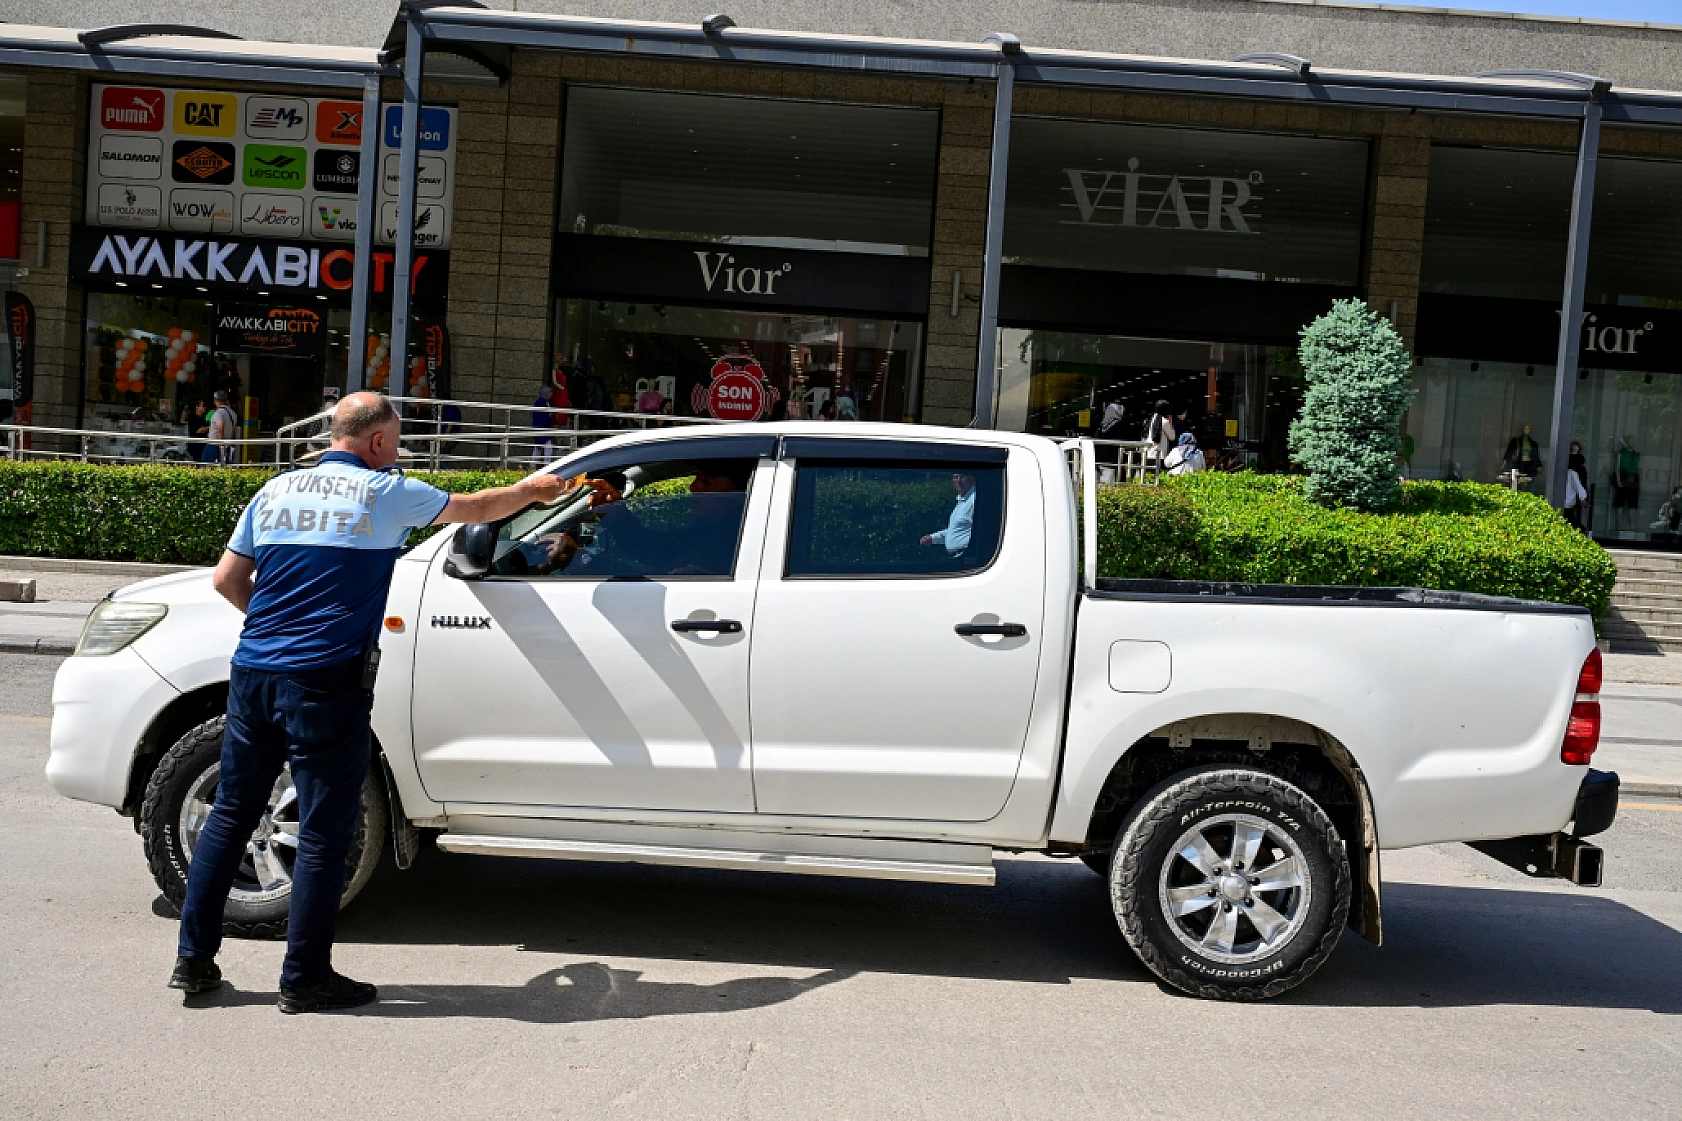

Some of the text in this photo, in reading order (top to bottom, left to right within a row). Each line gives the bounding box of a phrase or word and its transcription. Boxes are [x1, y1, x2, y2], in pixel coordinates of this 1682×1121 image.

[105, 107, 148, 124] PUMA
[185, 102, 224, 127] CAT
[101, 151, 161, 163] SALOMON
[184, 158, 223, 167] SCOOTER
[316, 174, 360, 186] LUMBERJ
[114, 207, 135, 215] POLO
[173, 202, 216, 218] WOW
[717, 385, 753, 399] SON
[259, 507, 375, 537] ZABITA
[431, 615, 493, 629] HILUX
